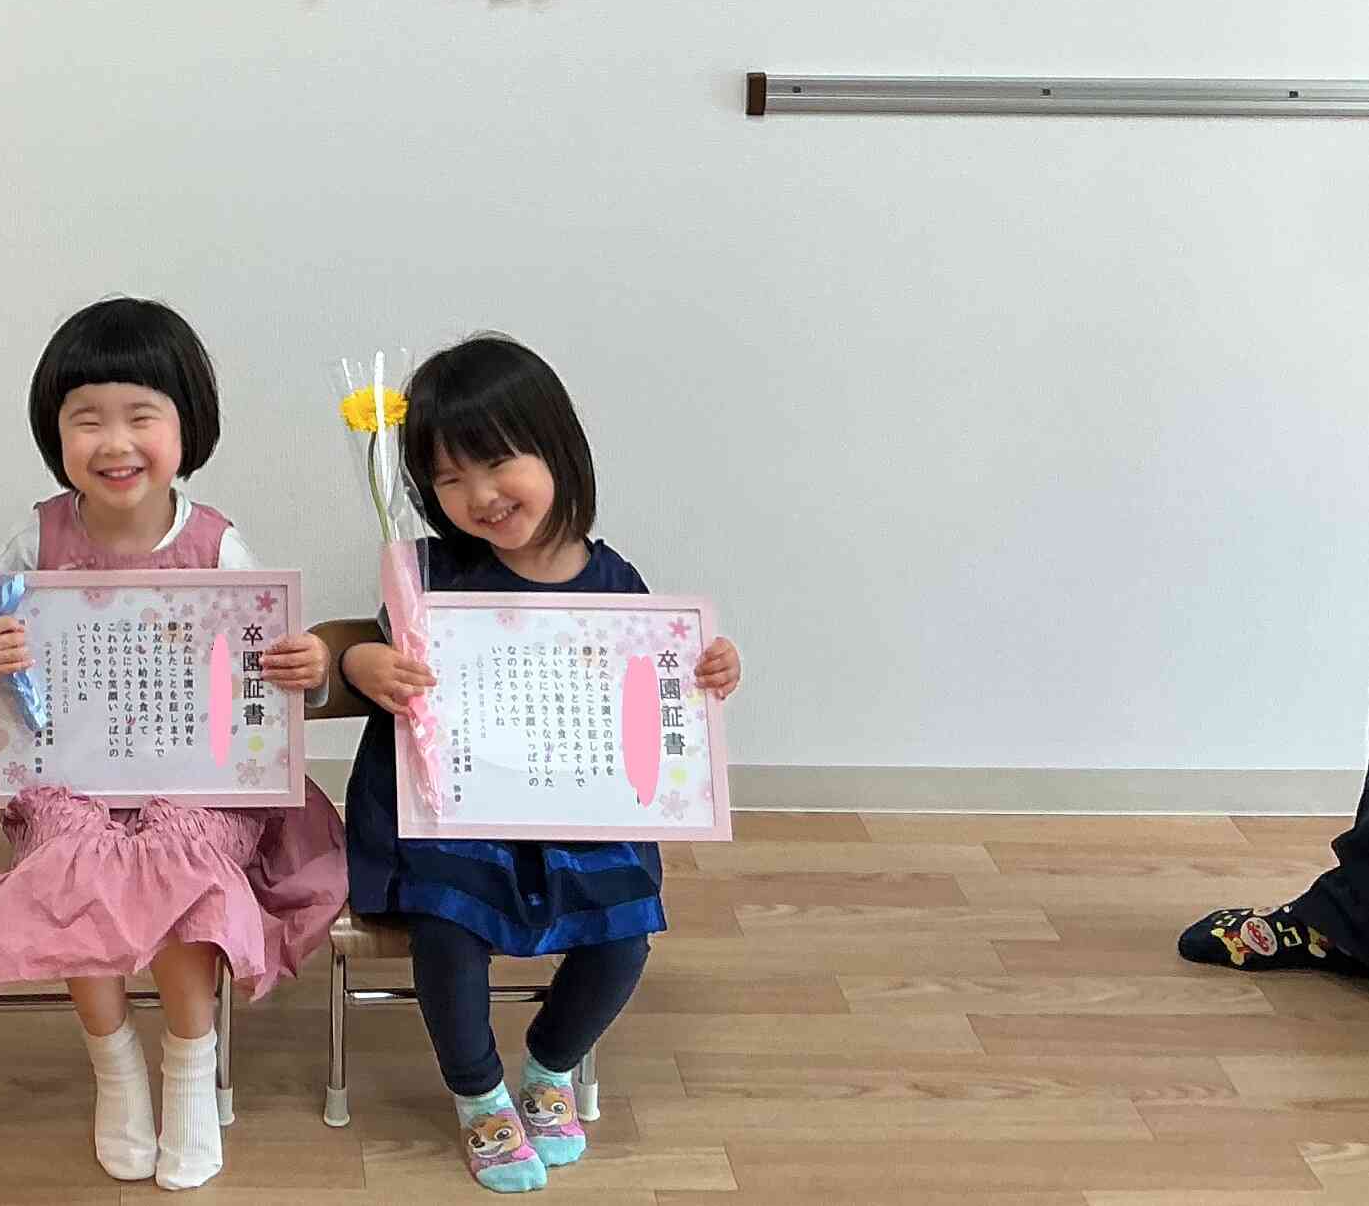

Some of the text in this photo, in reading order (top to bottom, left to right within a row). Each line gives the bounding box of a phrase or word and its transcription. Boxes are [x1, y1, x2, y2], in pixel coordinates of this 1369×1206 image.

[76, 623, 88, 701] いてくださいね
[107, 623, 119, 757] これからも笑顔いっぱいの
[122, 623, 134, 757] こんなに大きくなりました
[152, 622, 165, 757] お友だちと仲良くあそんで
[183, 622, 195, 746] あなたは本園での保育を
[241, 623, 265, 726] 卒園証書
[538, 646, 554, 787] こんなに大きくなりました
[568, 646, 586, 787] お友だちと仲良くあそんで
[599, 646, 615, 776] あなたは本園での保育を
[657, 650, 686, 756] 卒園証書
